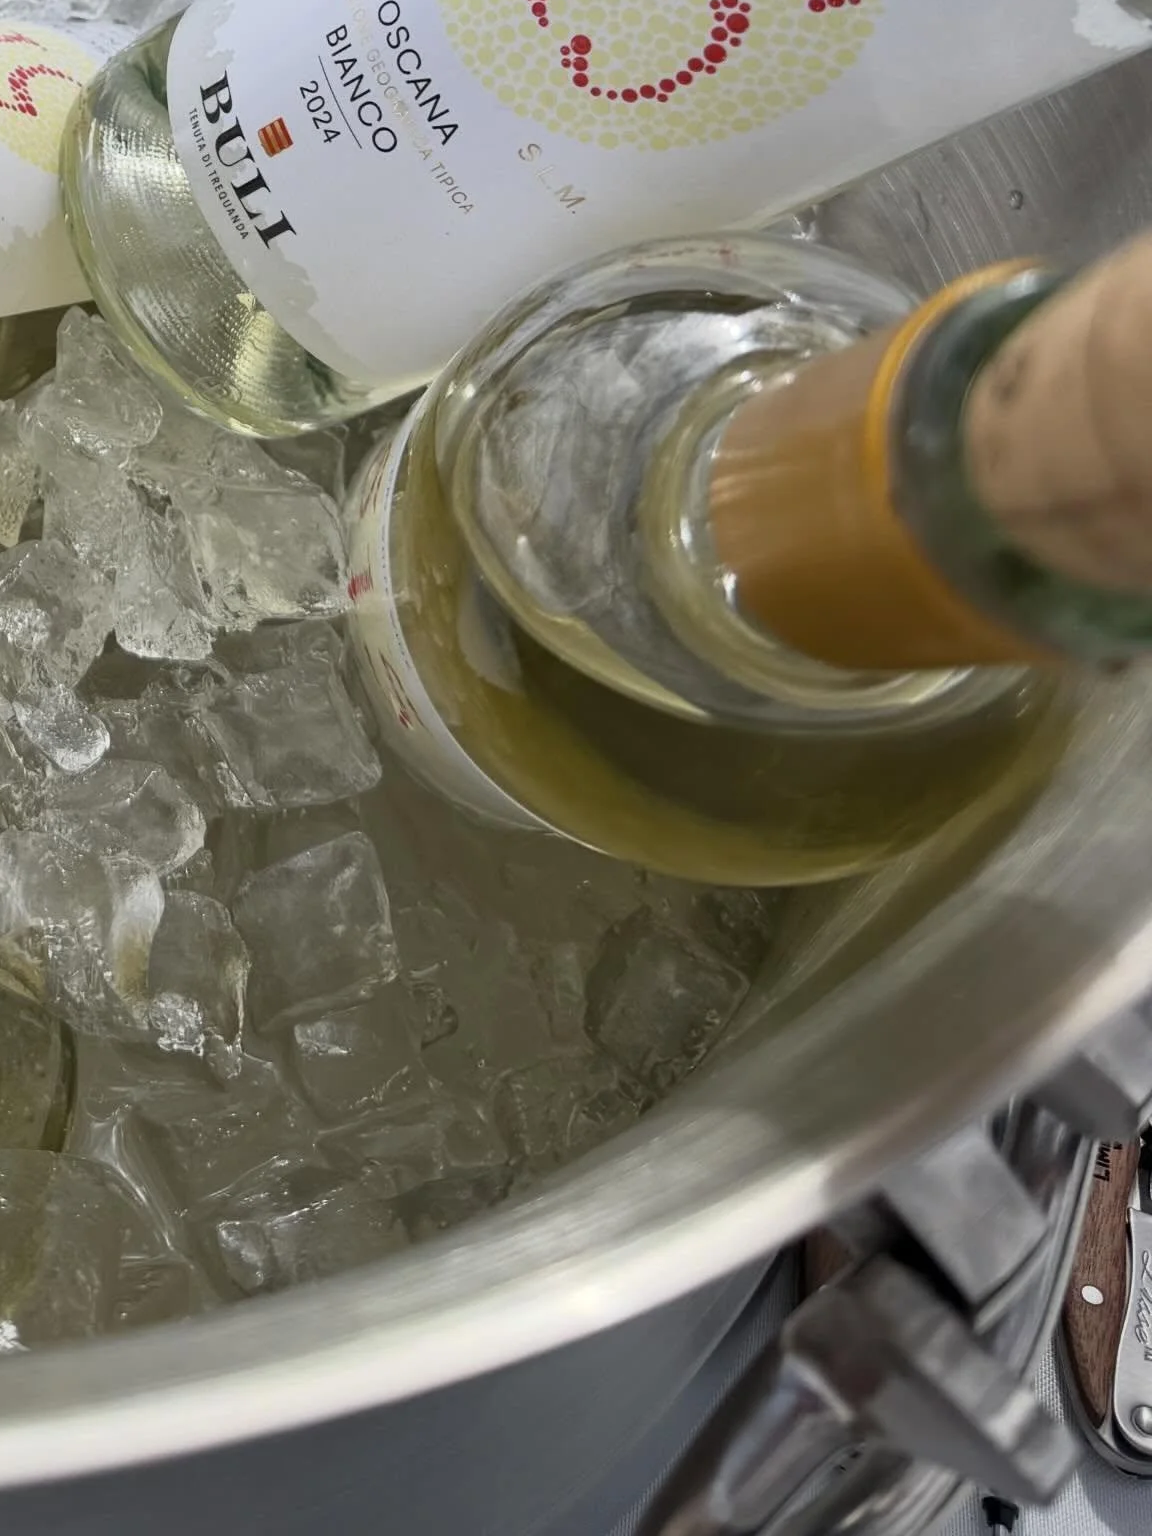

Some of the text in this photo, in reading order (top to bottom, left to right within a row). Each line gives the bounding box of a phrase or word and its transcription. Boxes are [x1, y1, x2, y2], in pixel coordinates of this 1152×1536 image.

[299, 80, 341, 144] 2024
[326, 23, 397, 153] BIANCO
[188, 108, 249, 240] TENUTA DI TREQUANDA
[200, 69, 296, 249] BULI
[430, 161, 475, 215] TIPICA
